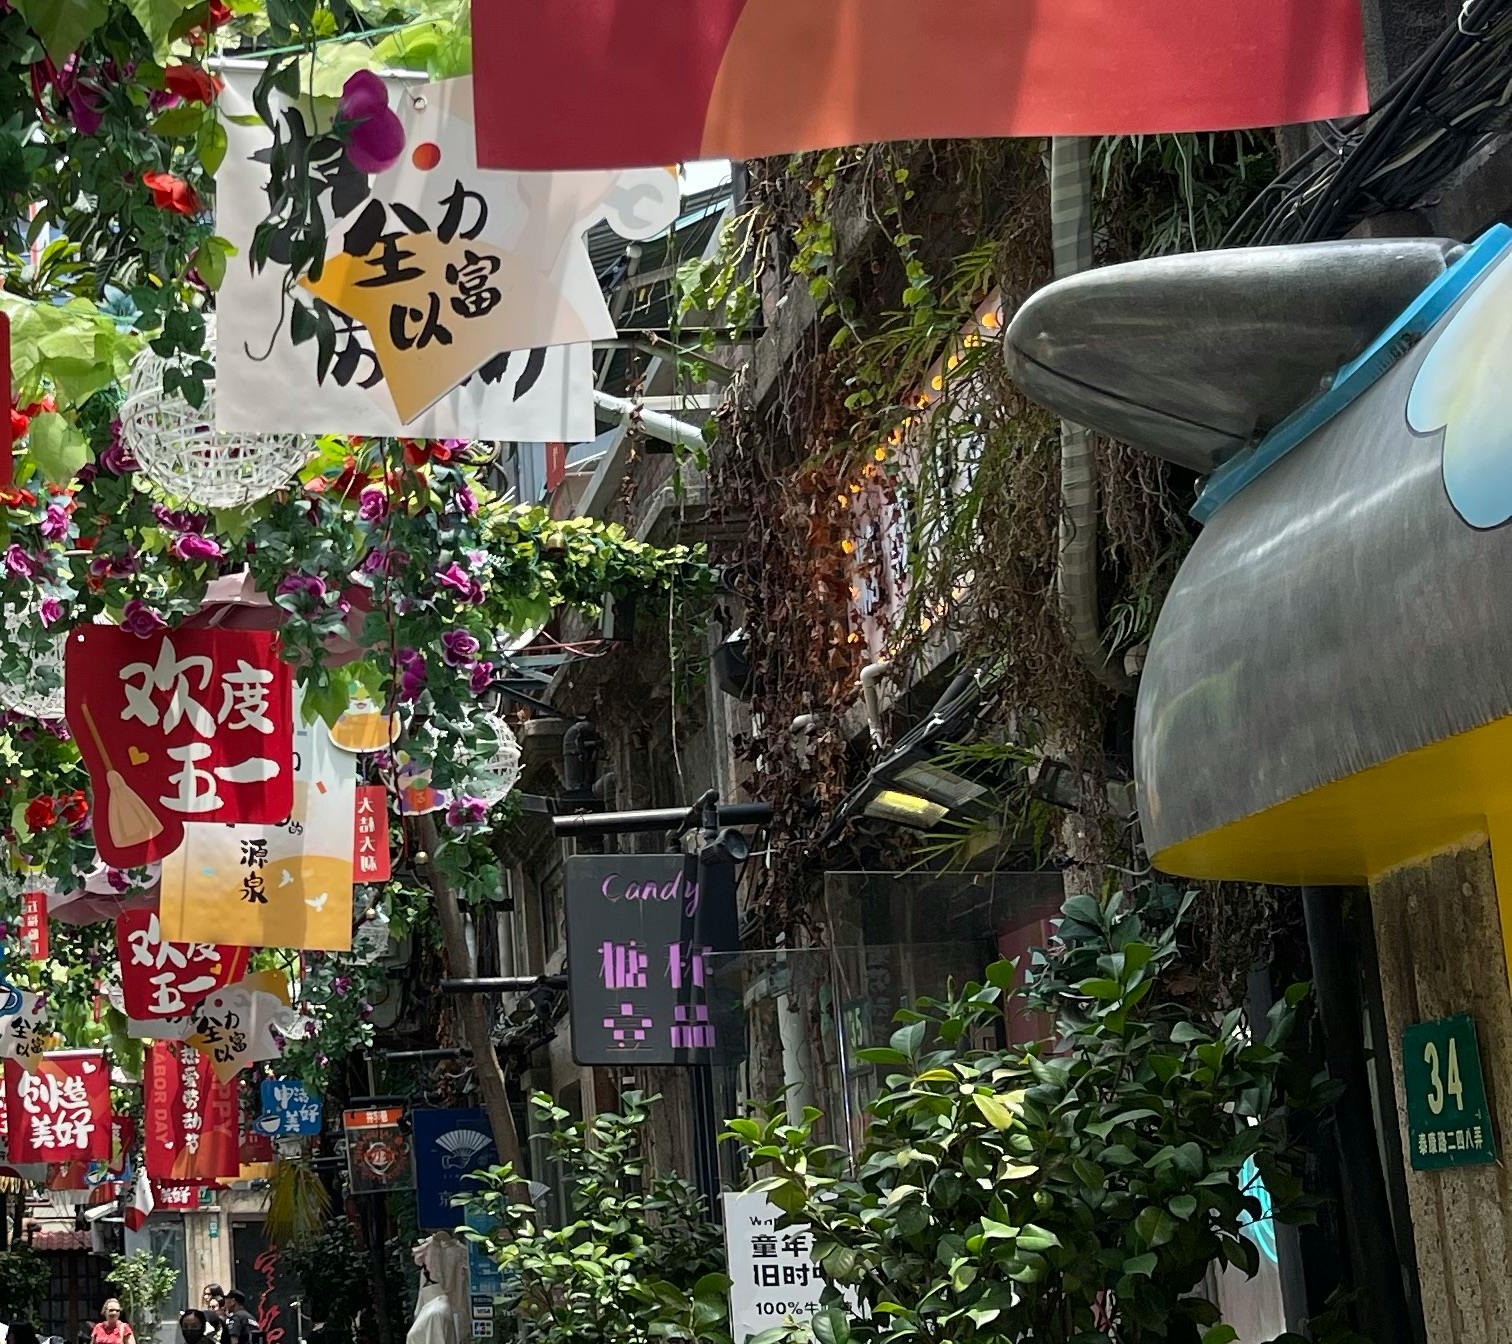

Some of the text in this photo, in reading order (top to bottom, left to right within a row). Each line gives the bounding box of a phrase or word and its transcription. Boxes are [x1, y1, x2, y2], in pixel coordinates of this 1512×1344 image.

[119, 636, 275, 738] 欢度
[159, 743, 281, 813] 五一
[240, 838, 269, 904] 源泉
[602, 870, 700, 918] Candy
[148, 973, 217, 1014] 五一
[18, 1070, 90, 1113] 创造
[1424, 1037, 1464, 1115] 34
[30, 1108, 95, 1150] 美好
